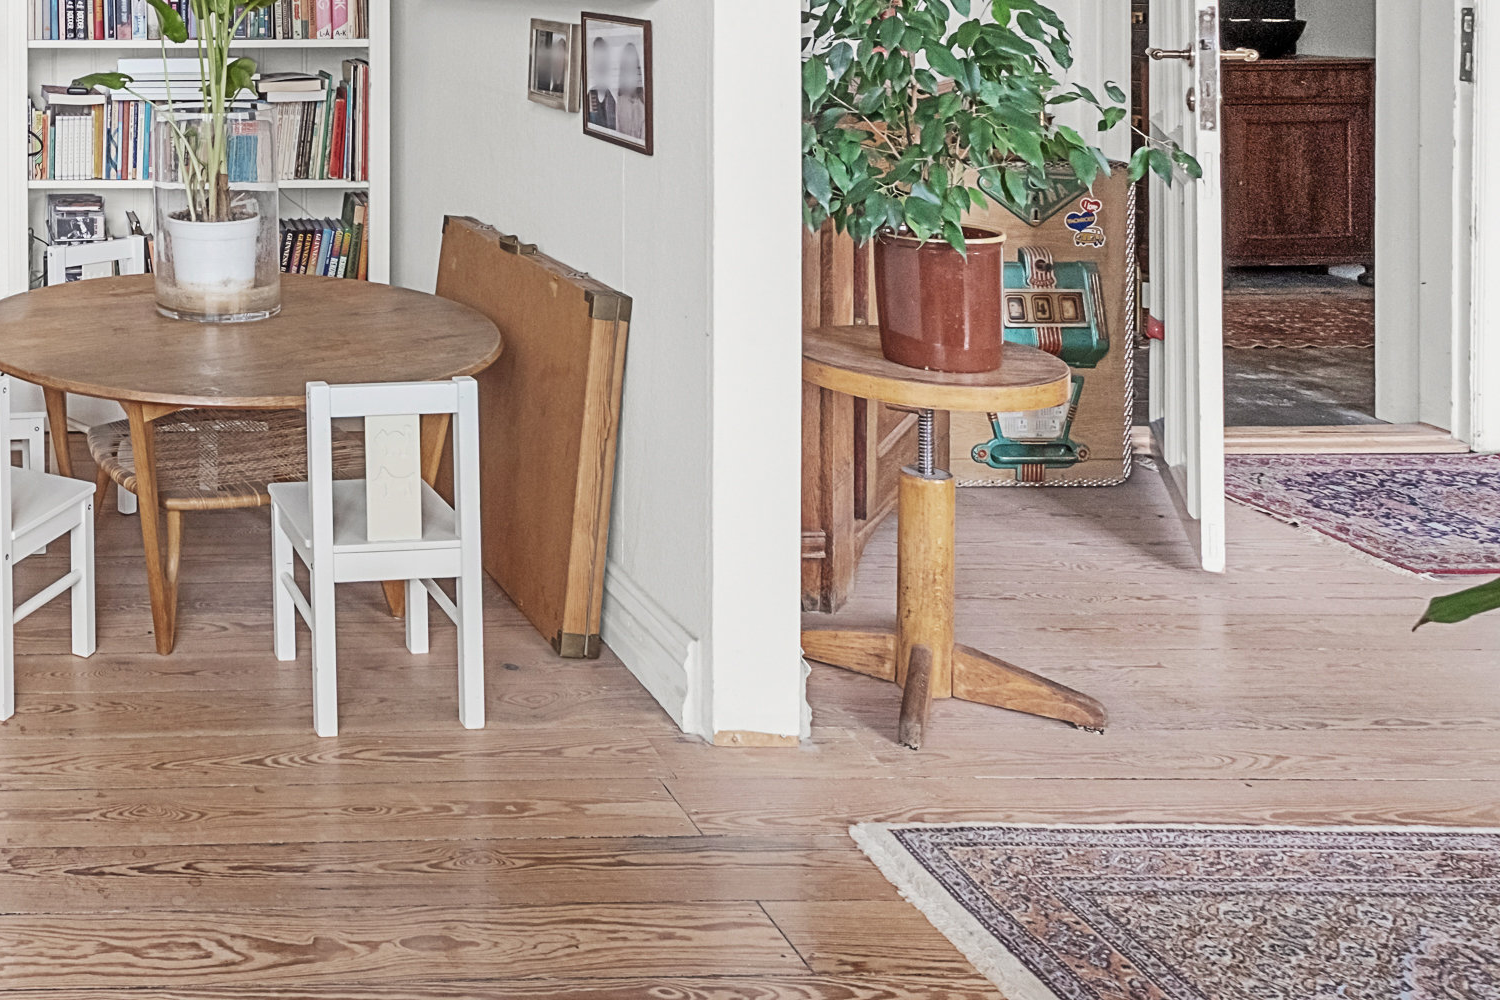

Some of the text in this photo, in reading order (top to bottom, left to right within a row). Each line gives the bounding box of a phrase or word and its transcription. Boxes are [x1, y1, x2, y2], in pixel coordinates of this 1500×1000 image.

[282, 232, 293, 266] GUINNESS
[293, 233, 304, 266] GUINNESS
[301, 233, 313, 266] GUINNESS
[311, 233, 322, 265] GUINNESS
[1036, 300, 1047, 315] 4
